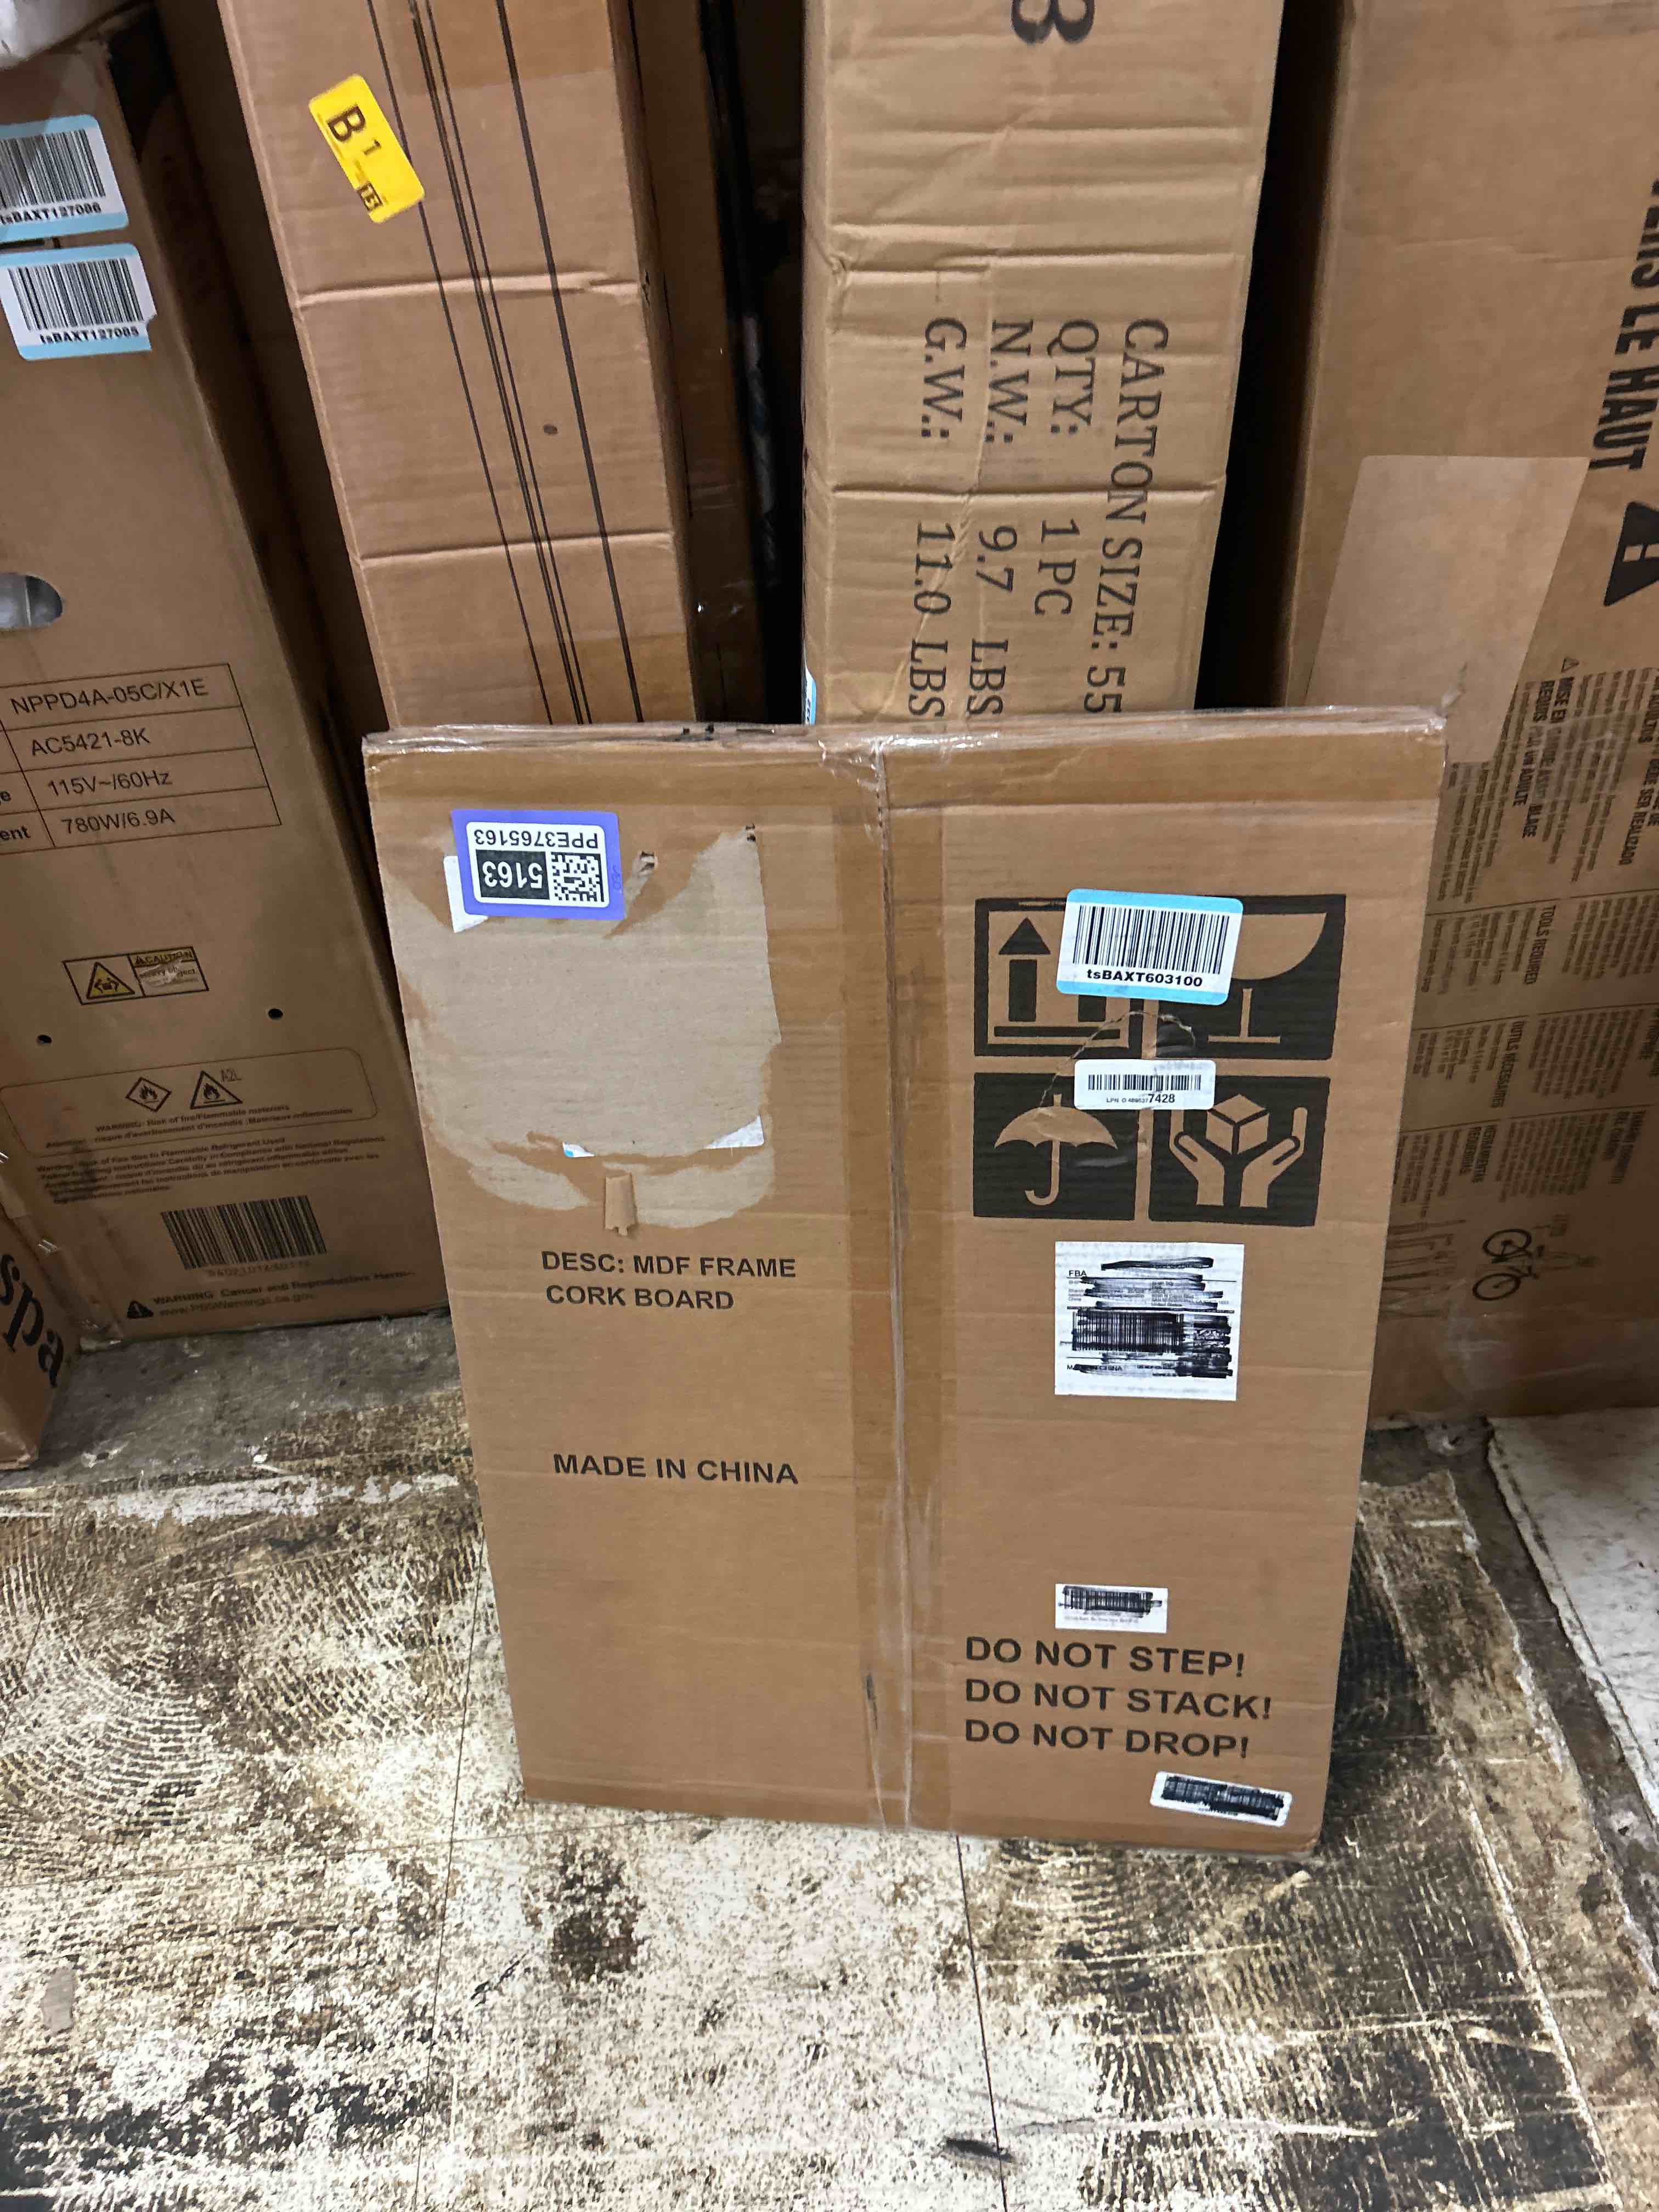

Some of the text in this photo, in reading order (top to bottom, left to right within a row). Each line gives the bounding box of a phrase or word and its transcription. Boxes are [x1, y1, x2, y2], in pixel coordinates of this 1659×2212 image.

[326, 104, 366, 142] B
[1105, 318, 1169, 524] CARTON
[1589, 366, 1659, 471] HAUT
[1034, 319, 1100, 615] QTY: 1 PC
[907, 317, 967, 718] G.W.: 11.0 LBS
[966, 318, 1034, 716] N.W.: 9.7 LBS
[1091, 537, 1143, 650] SIZE:
[10, 678, 209, 715] NPPD4A-05C/X1E
[30, 727, 151, 757] AC5421-8K
[61, 806, 176, 834] 780W/6.9A
[473, 829, 599, 849] PPE3765163
[481, 861, 543, 889] 5163
[1087, 968, 1203, 988] tsBAXT603100
[541, 1250, 797, 1278] DESC: MDF FRAME
[545, 1284, 735, 1310] CORK BOARD
[553, 1453, 799, 1485] MADE IN CHINA
[966, 1636, 1245, 1678] DO NOT STEP!
[966, 1678, 1272, 1720] DO NOT STACK!
[965, 1719, 1249, 1759] DO NOT DROP!
